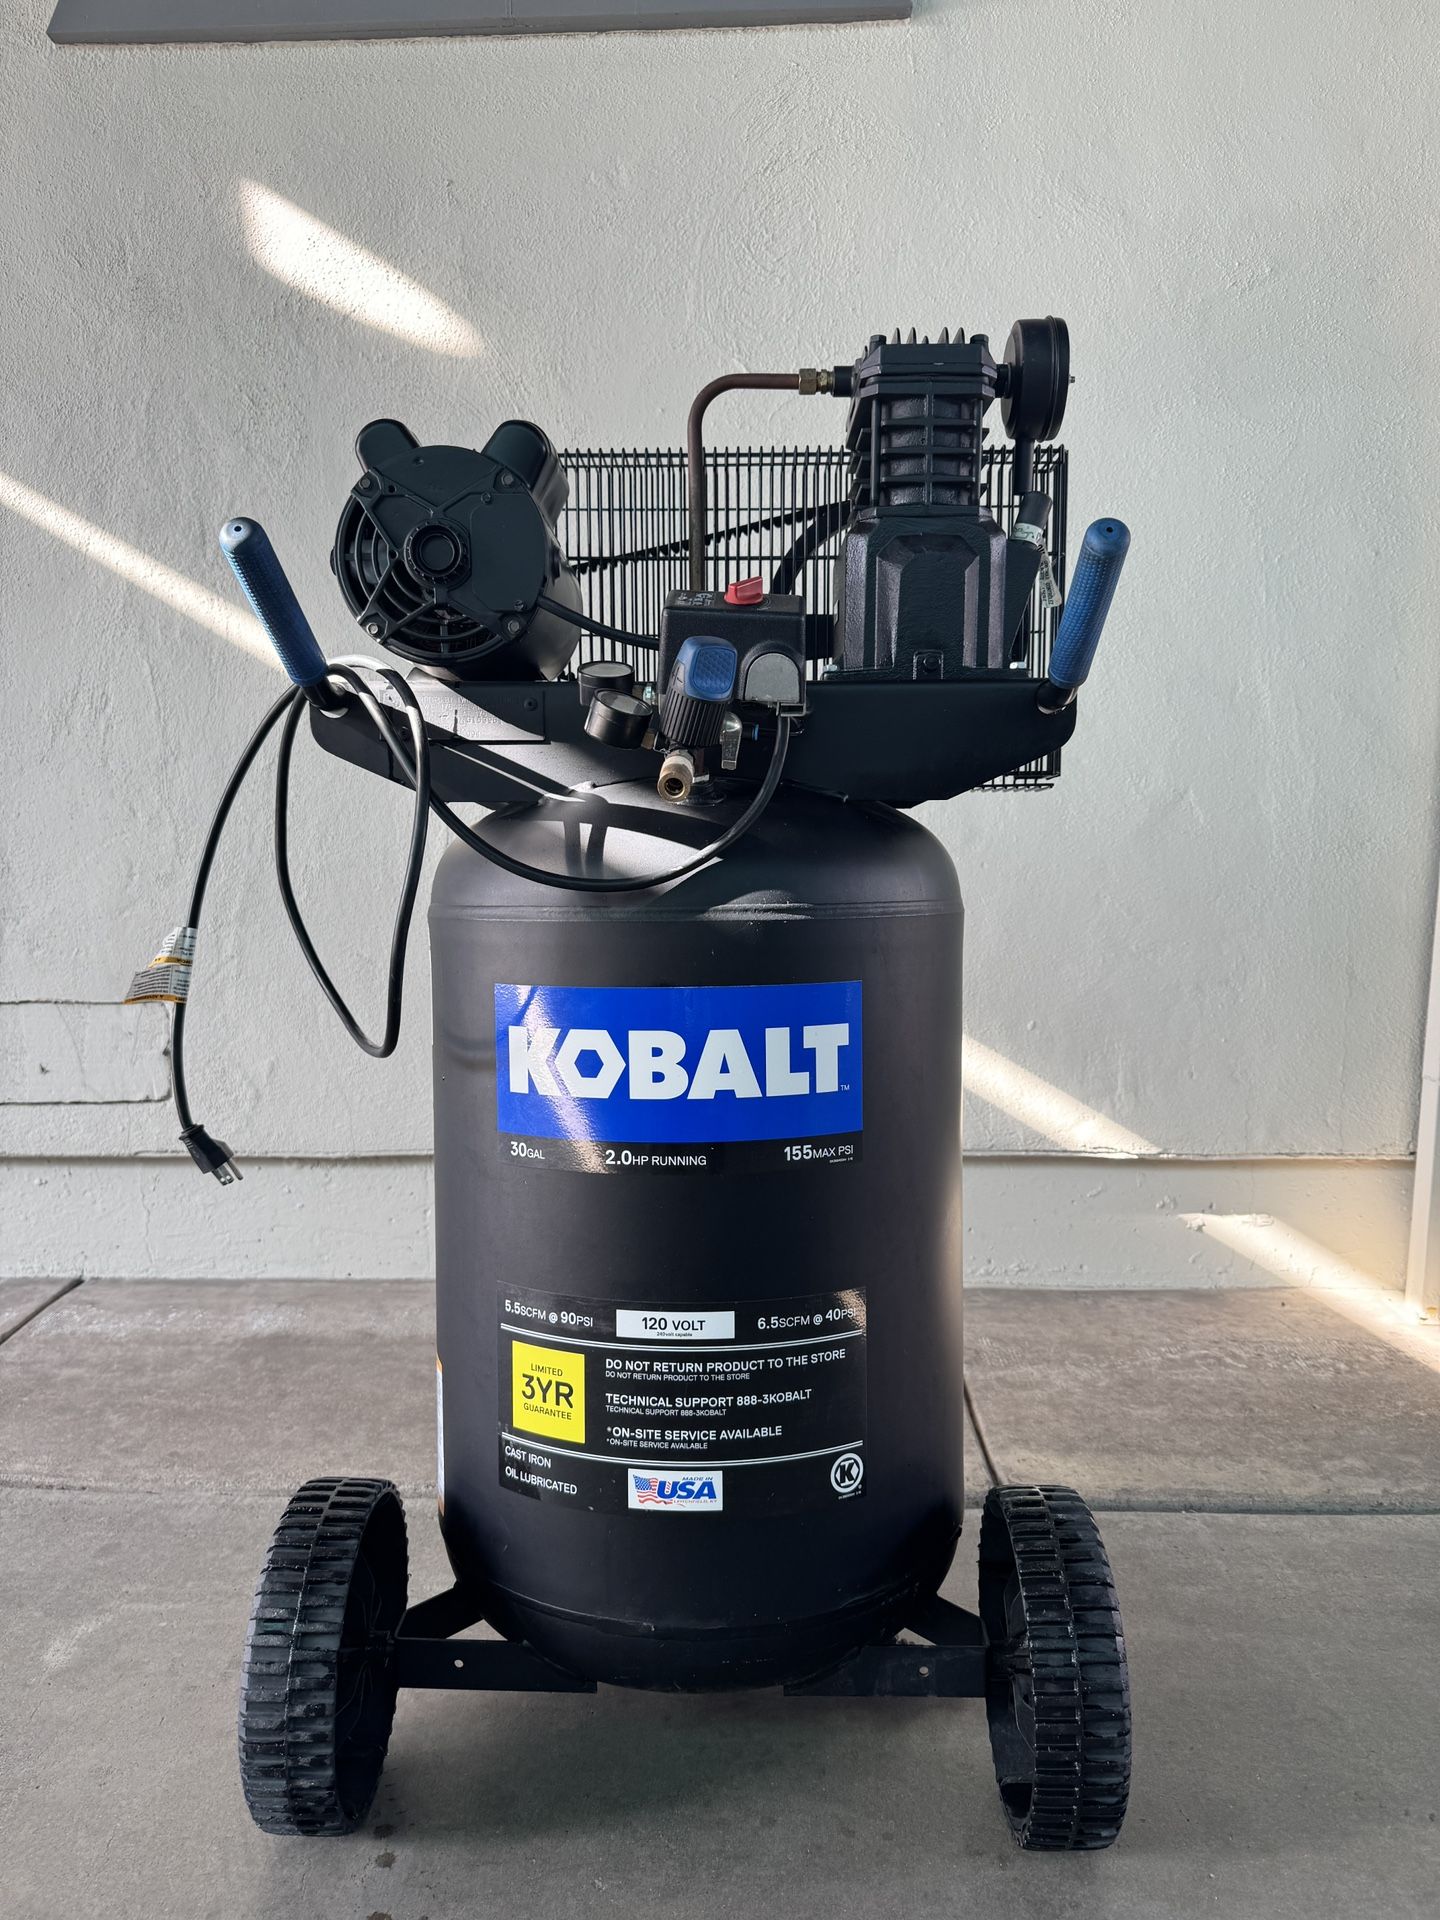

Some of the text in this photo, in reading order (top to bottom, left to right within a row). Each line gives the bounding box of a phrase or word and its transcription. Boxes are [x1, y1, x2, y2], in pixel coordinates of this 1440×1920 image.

[508, 1023, 849, 1100] KOBALT
[510, 1141, 546, 1159] 30GAL
[605, 1149, 707, 1166] 2.0HP RUNNING
[784, 1144, 836, 1161] 155MAX
[838, 1144, 854, 1156] PSI
[504, 1299, 593, 1327] 5.5SCFM @ 90PSI
[757, 1308, 857, 1330] 6.5SCFM @ 40PSI
[642, 1317, 706, 1331] 120 VOLT
[605, 1348, 846, 1373] DO NOT RETURN PRODUCT TO THE STORE
[531, 1363, 563, 1377] LIMITED
[605, 1370, 615, 1378] DO
[617, 1371, 631, 1379] NOT
[633, 1372, 661, 1380] RETURN
[522, 1373, 574, 1409] 3YR
[605, 1389, 812, 1407] TECHNICAL SUPPORT 888-3KOBALT
[523, 1402, 572, 1420] GUARANTEE
[605, 1405, 644, 1415] TECHNICAL
[645, 1408, 679, 1416] SUPPORT
[664, 1429, 717, 1440] SERVICE
[720, 1426, 782, 1440] AVAILABLE
[639, 1440, 669, 1449] SERVICE
[504, 1446, 551, 1468] CAST IRON
[504, 1466, 578, 1495] OIL LUBRICATED
[657, 1480, 717, 1500] USA
